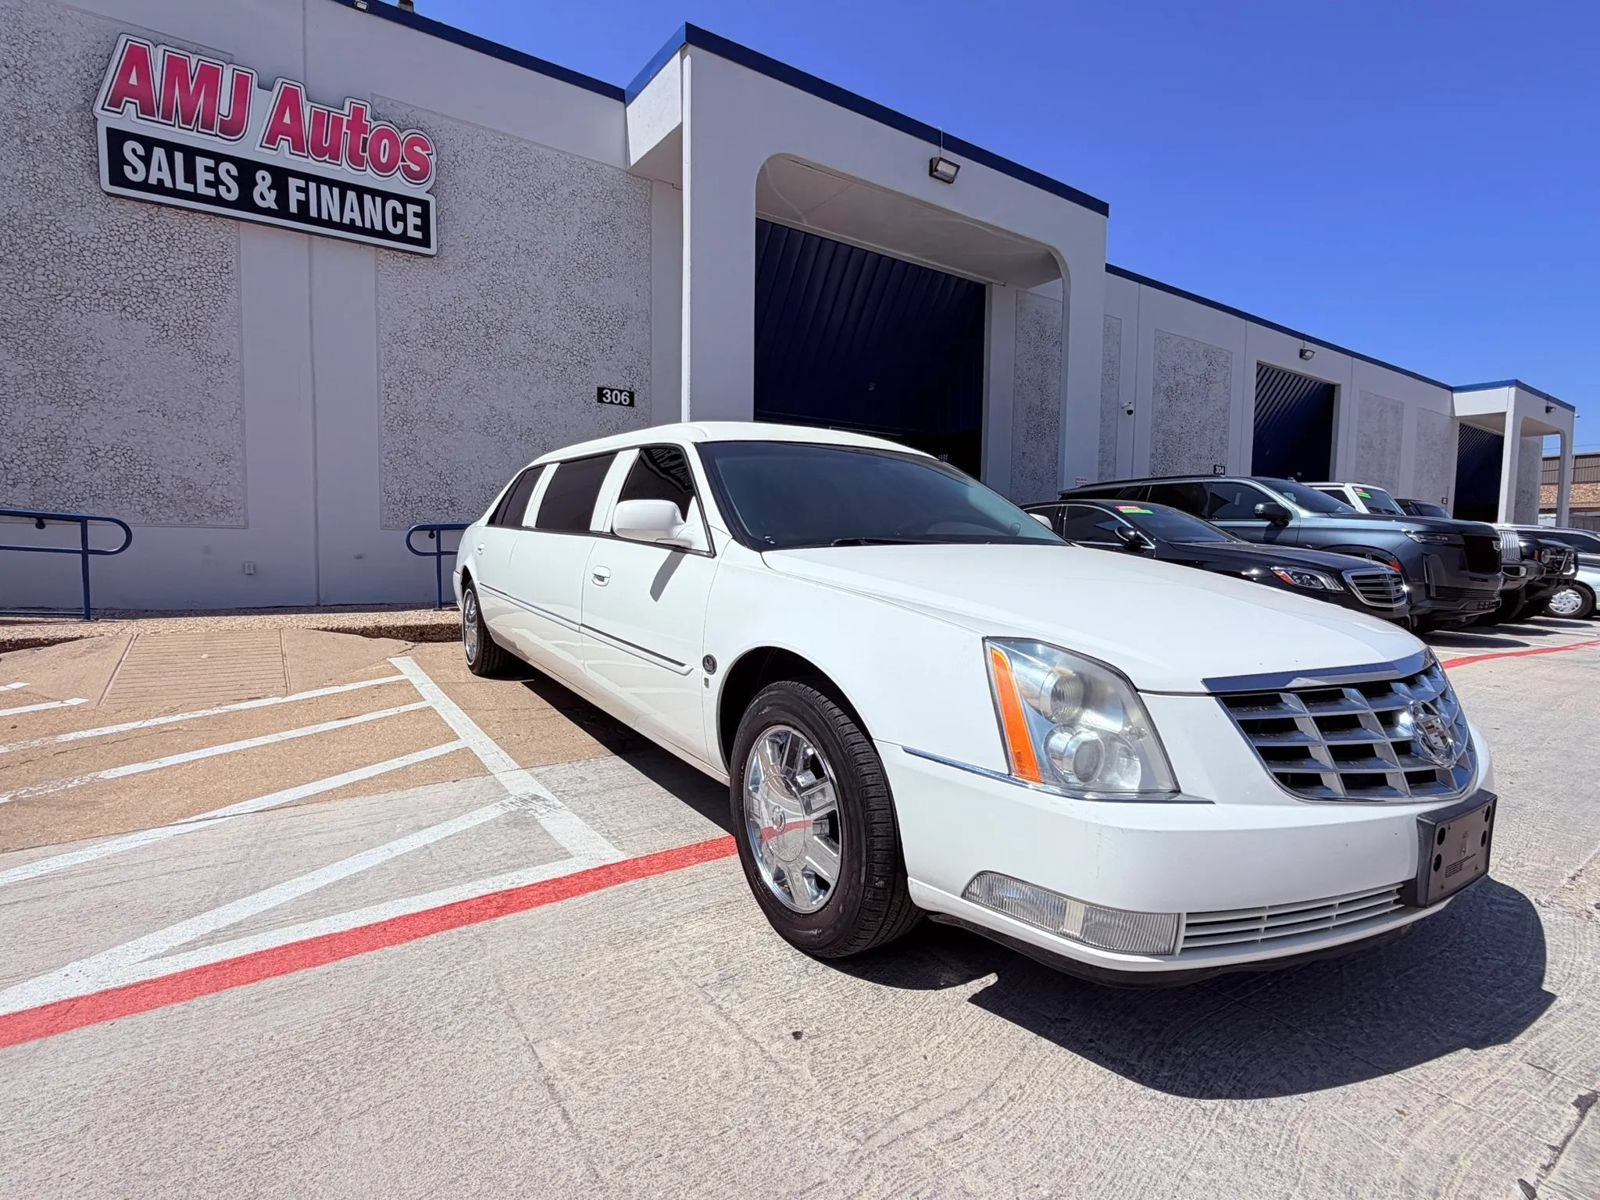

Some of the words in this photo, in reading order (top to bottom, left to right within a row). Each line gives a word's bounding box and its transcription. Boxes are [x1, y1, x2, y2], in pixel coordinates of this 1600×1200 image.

[103, 40, 254, 140] AMJ
[261, 79, 433, 183] Autos
[122, 140, 240, 201] SALES
[252, 170, 279, 211] &
[288, 177, 423, 239] FINANCE
[602, 389, 630, 405] 306
